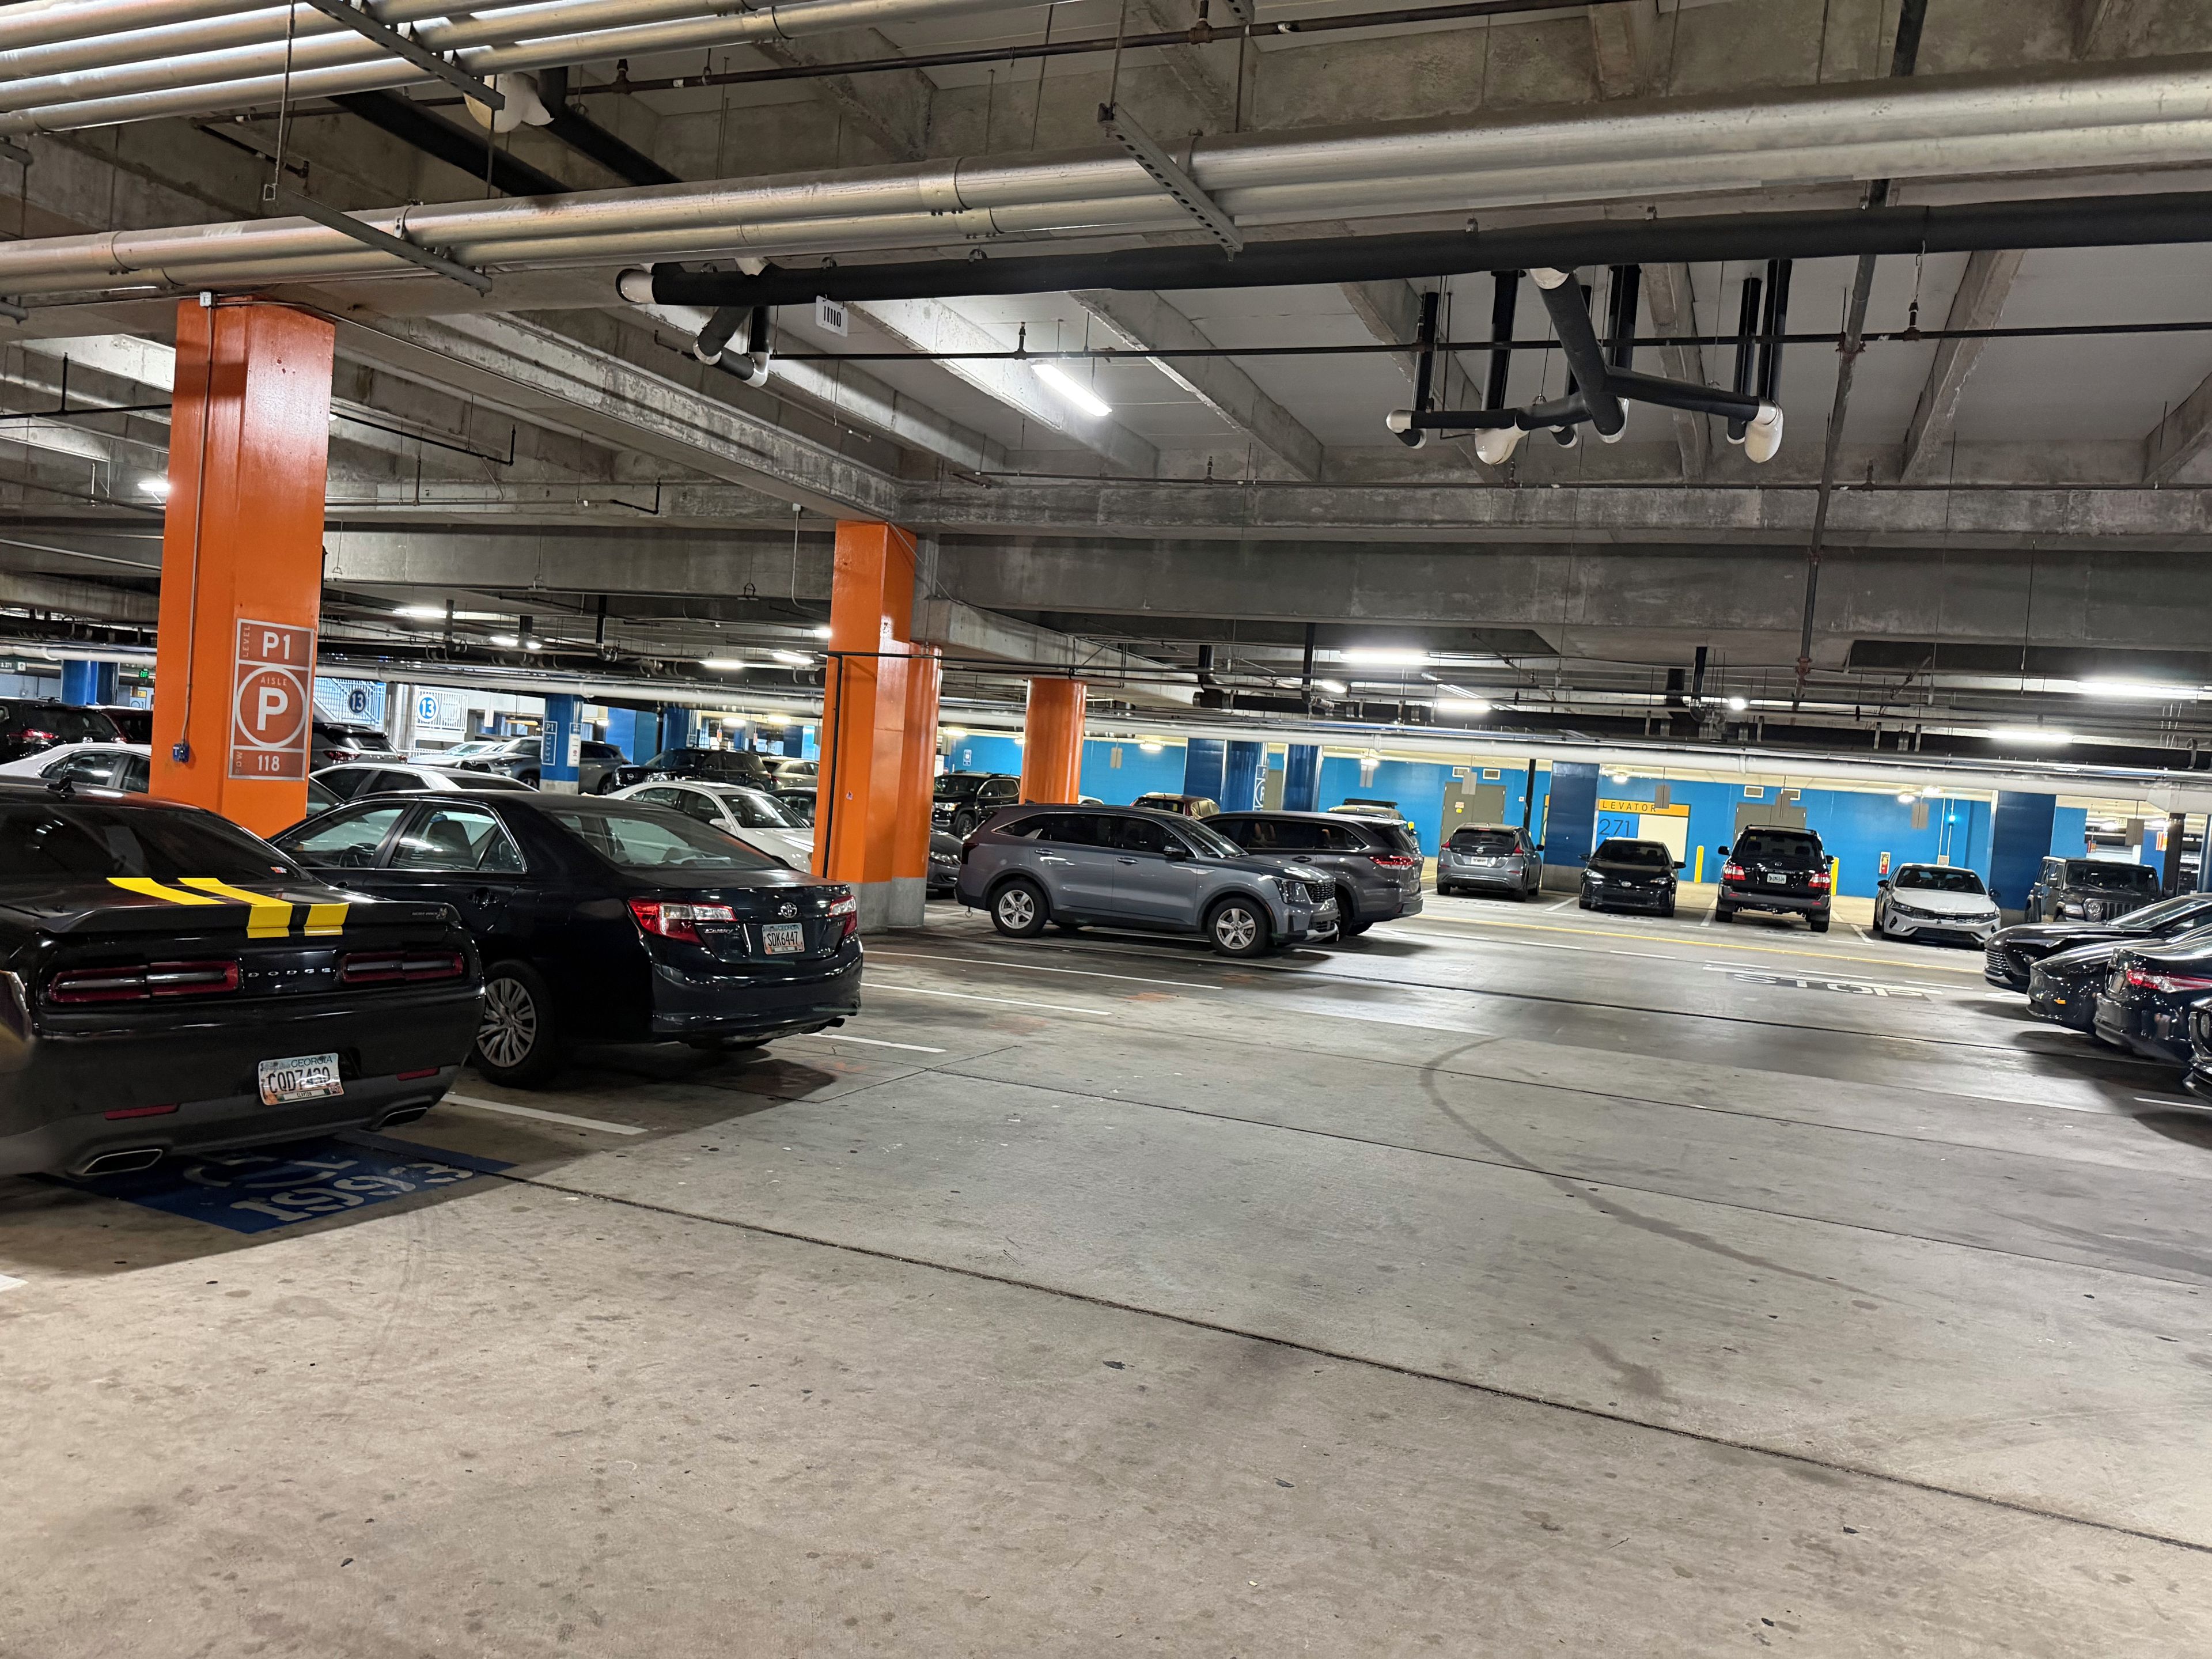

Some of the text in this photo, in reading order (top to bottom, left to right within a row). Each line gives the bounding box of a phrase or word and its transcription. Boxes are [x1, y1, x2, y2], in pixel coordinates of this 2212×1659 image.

[262, 631, 290, 660] P1
[260, 676, 287, 686] AISLE
[257, 686, 288, 730] P
[352, 694, 364, 711] 13
[421, 699, 434, 717] 13
[547, 724, 554, 732] P1
[258, 755, 280, 771] 118
[1603, 801, 1656, 812] LEVATOR
[1599, 819, 1630, 836] 271
[767, 931, 798, 946] SDK6447
[248, 967, 331, 978] DODGE
[1733, 974, 1923, 997] STOP
[291, 1055, 332, 1068] GEORGIA
[230, 1162, 474, 1221] 1993
